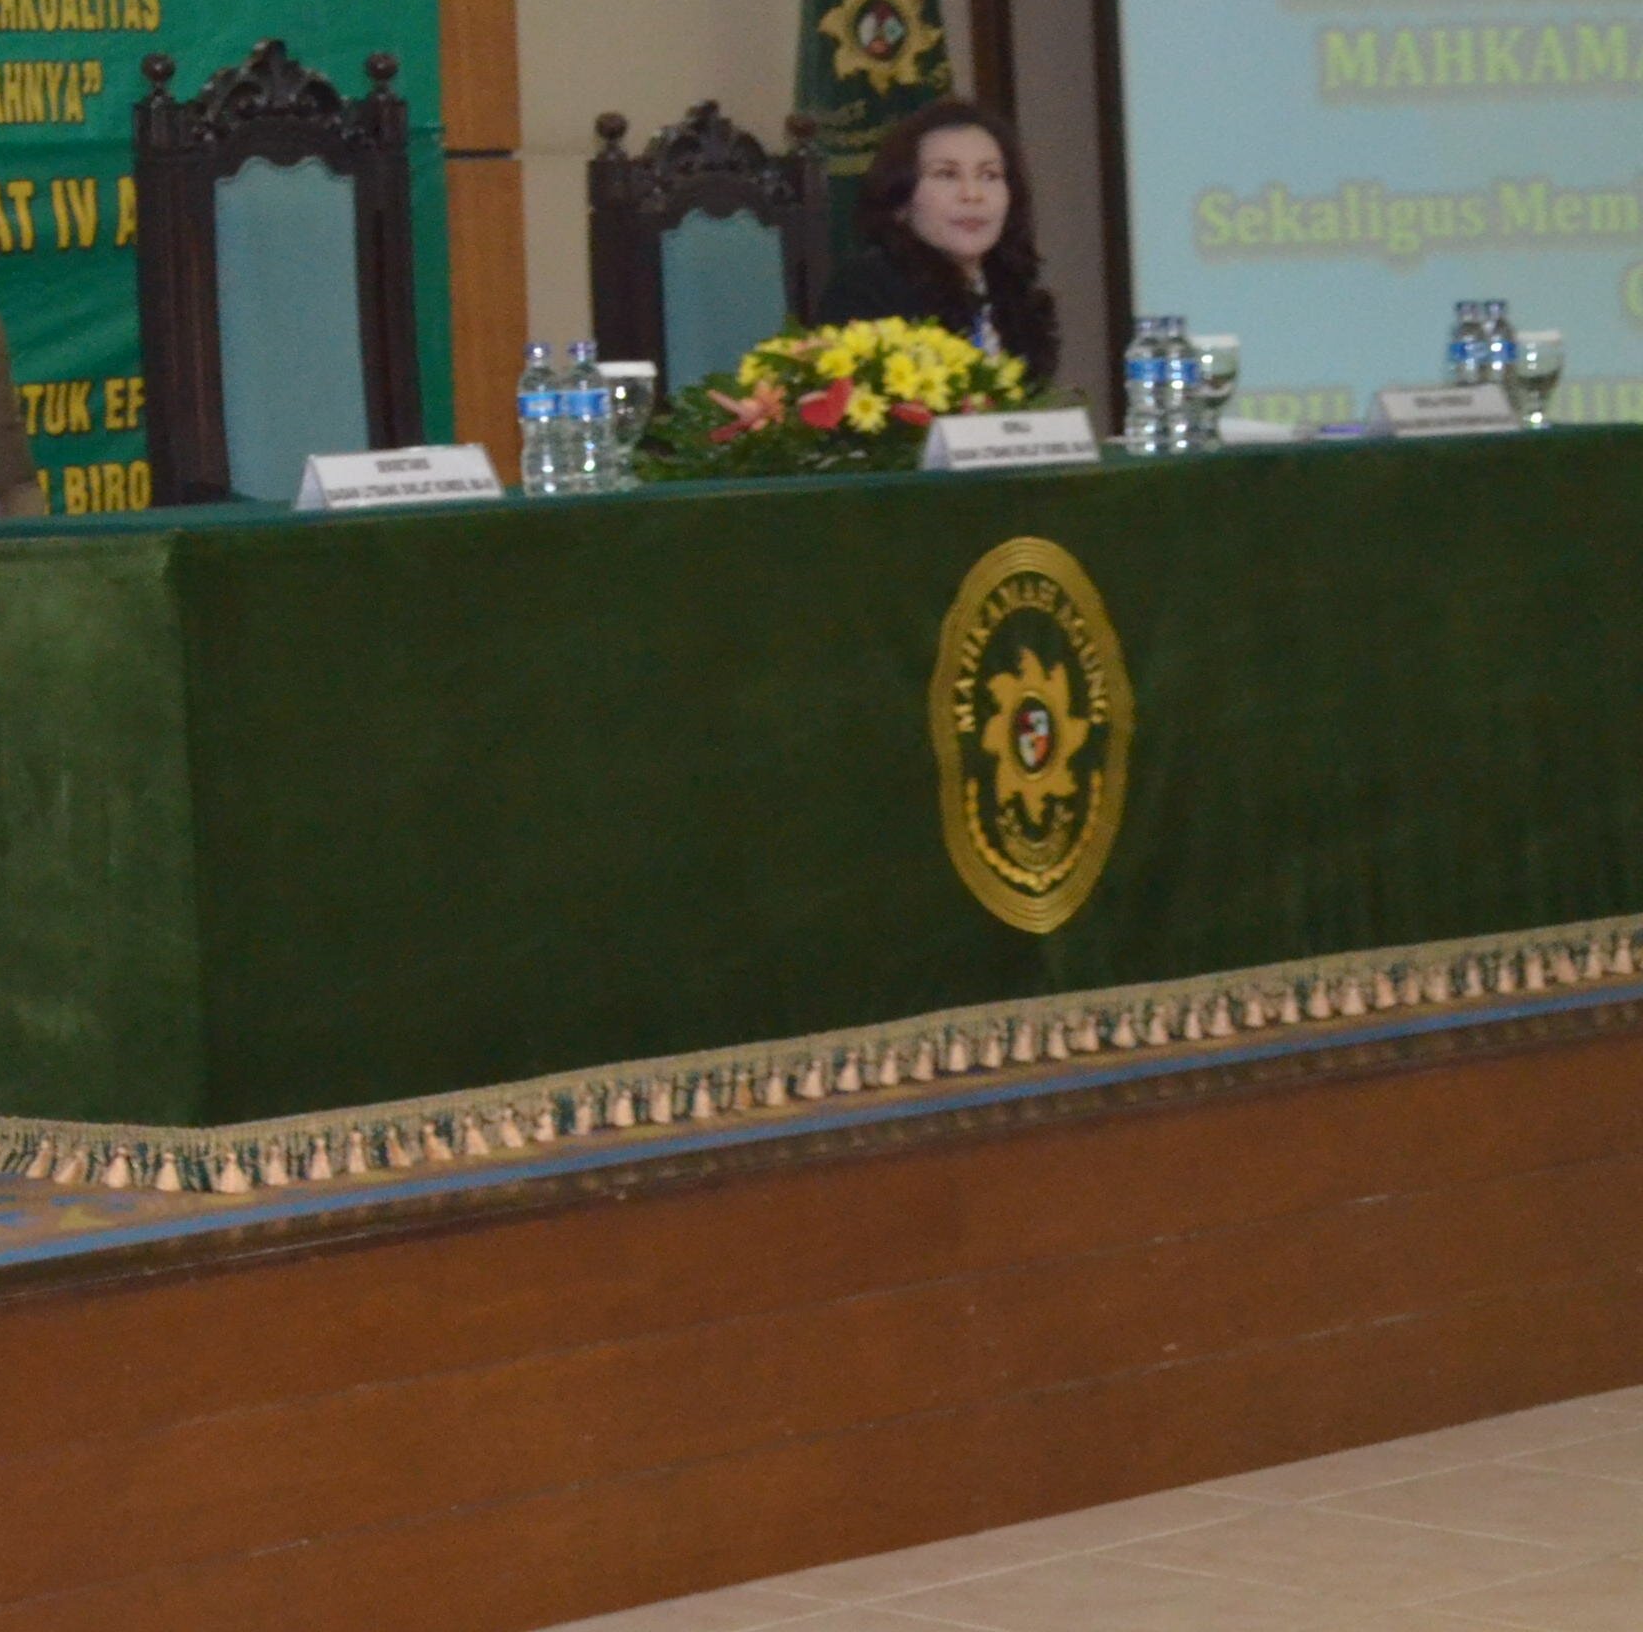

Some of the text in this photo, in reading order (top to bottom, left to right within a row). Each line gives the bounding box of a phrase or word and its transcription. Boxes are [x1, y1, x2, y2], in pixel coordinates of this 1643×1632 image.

[1324, 24, 1643, 90] MAHKAM
[50, 177, 99, 249] IV
[1197, 180, 1643, 255] Sekaligus Mem
[21, 379, 93, 437] TUK
[63, 458, 153, 517] BIRO
